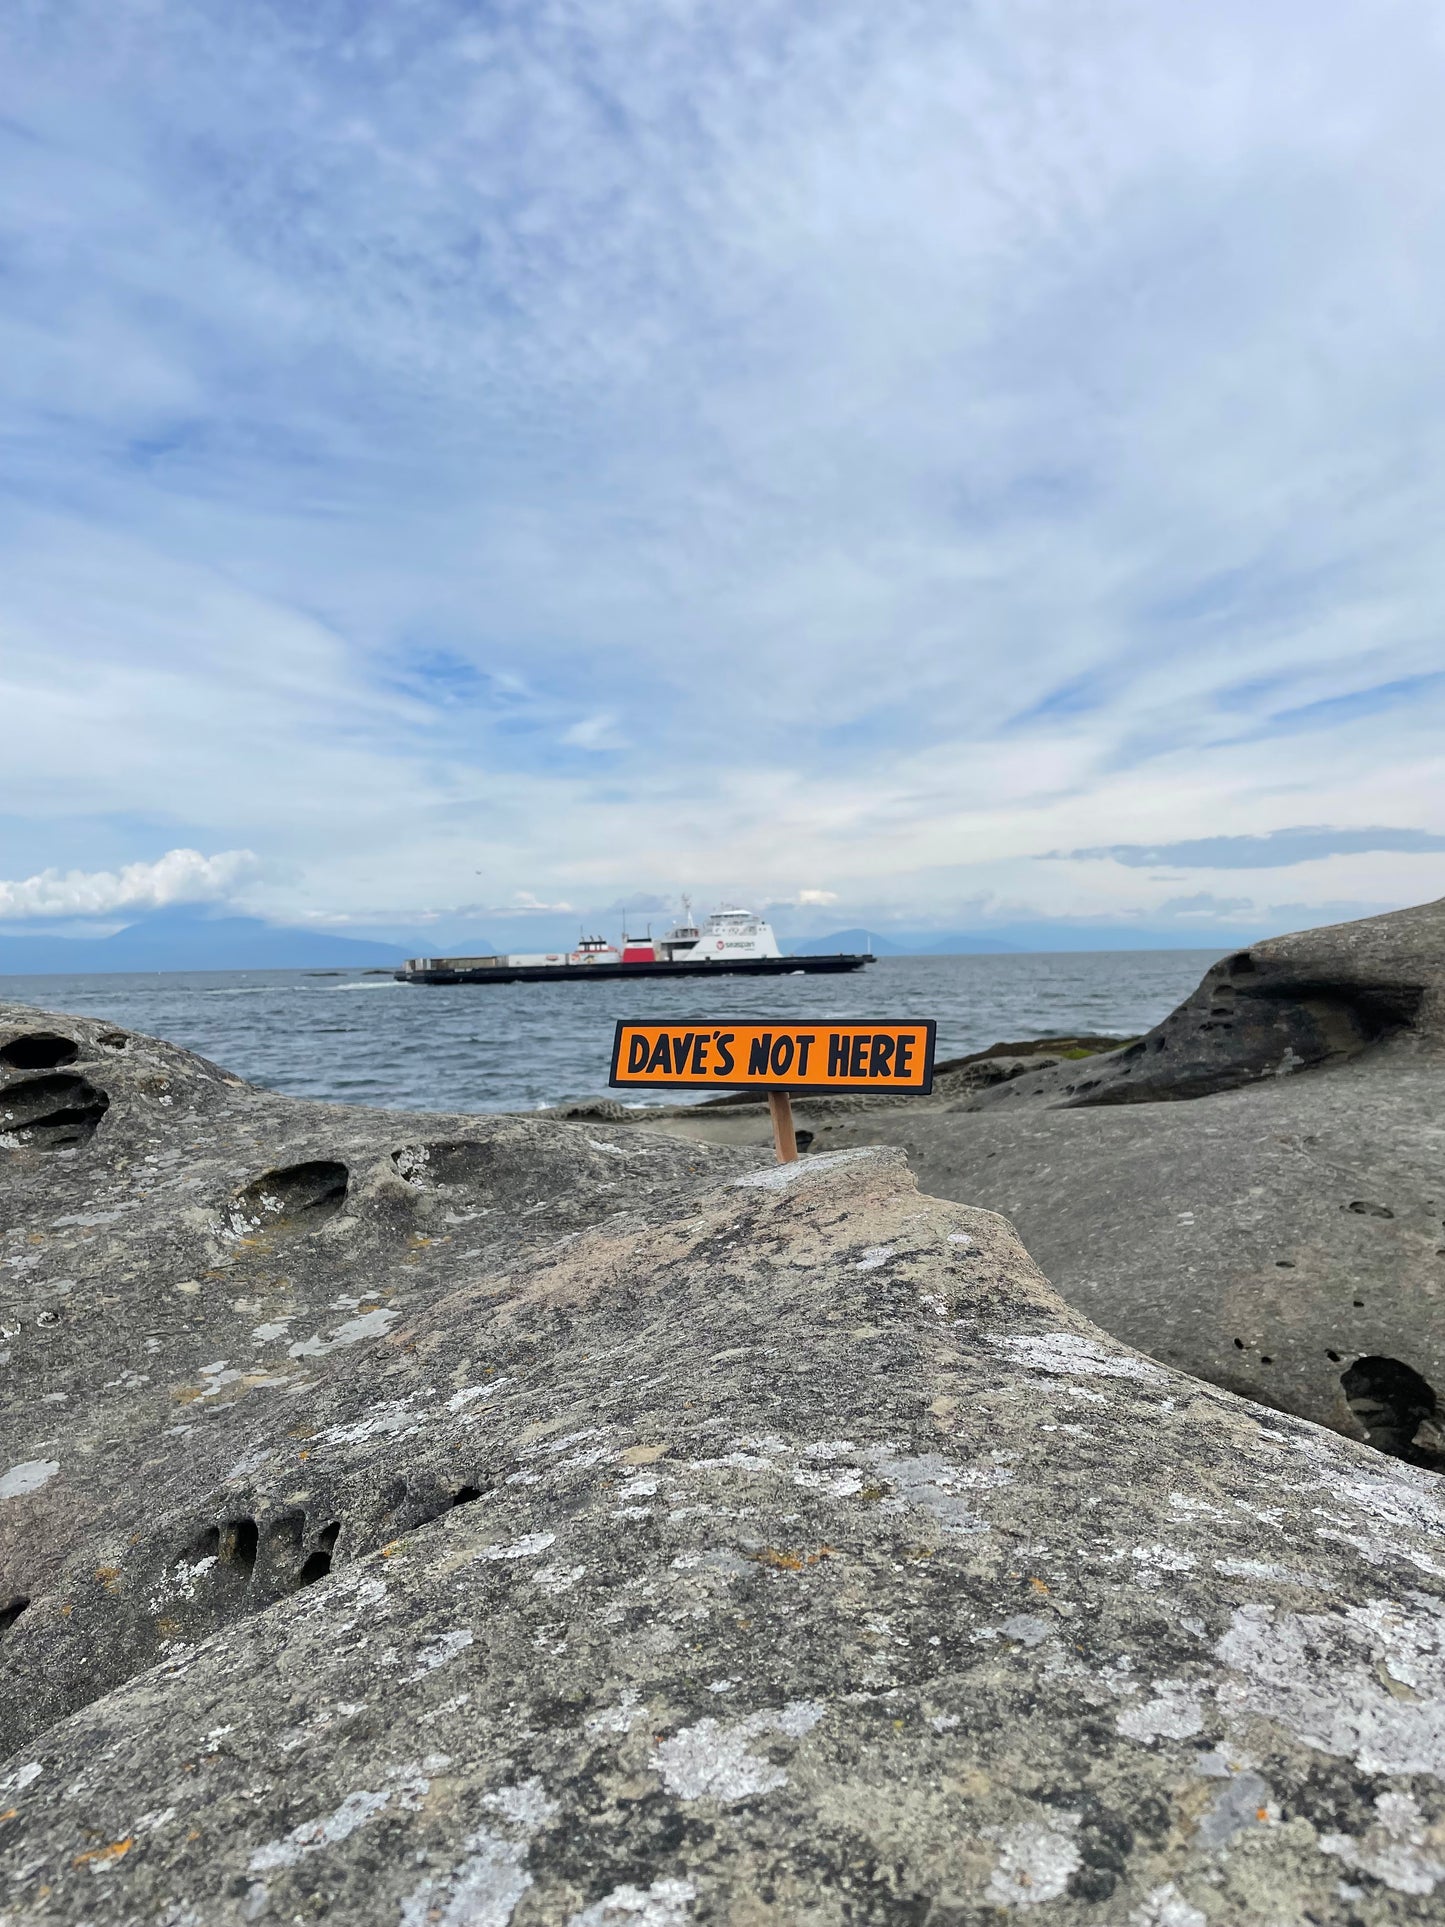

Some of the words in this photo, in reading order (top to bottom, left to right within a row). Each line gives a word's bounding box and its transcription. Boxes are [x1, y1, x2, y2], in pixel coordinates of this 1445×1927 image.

[725, 941, 755, 949] seaspan
[628, 1031, 735, 1076] DAVE'S
[748, 1034, 815, 1076] NOT
[828, 1034, 915, 1077] HERE
